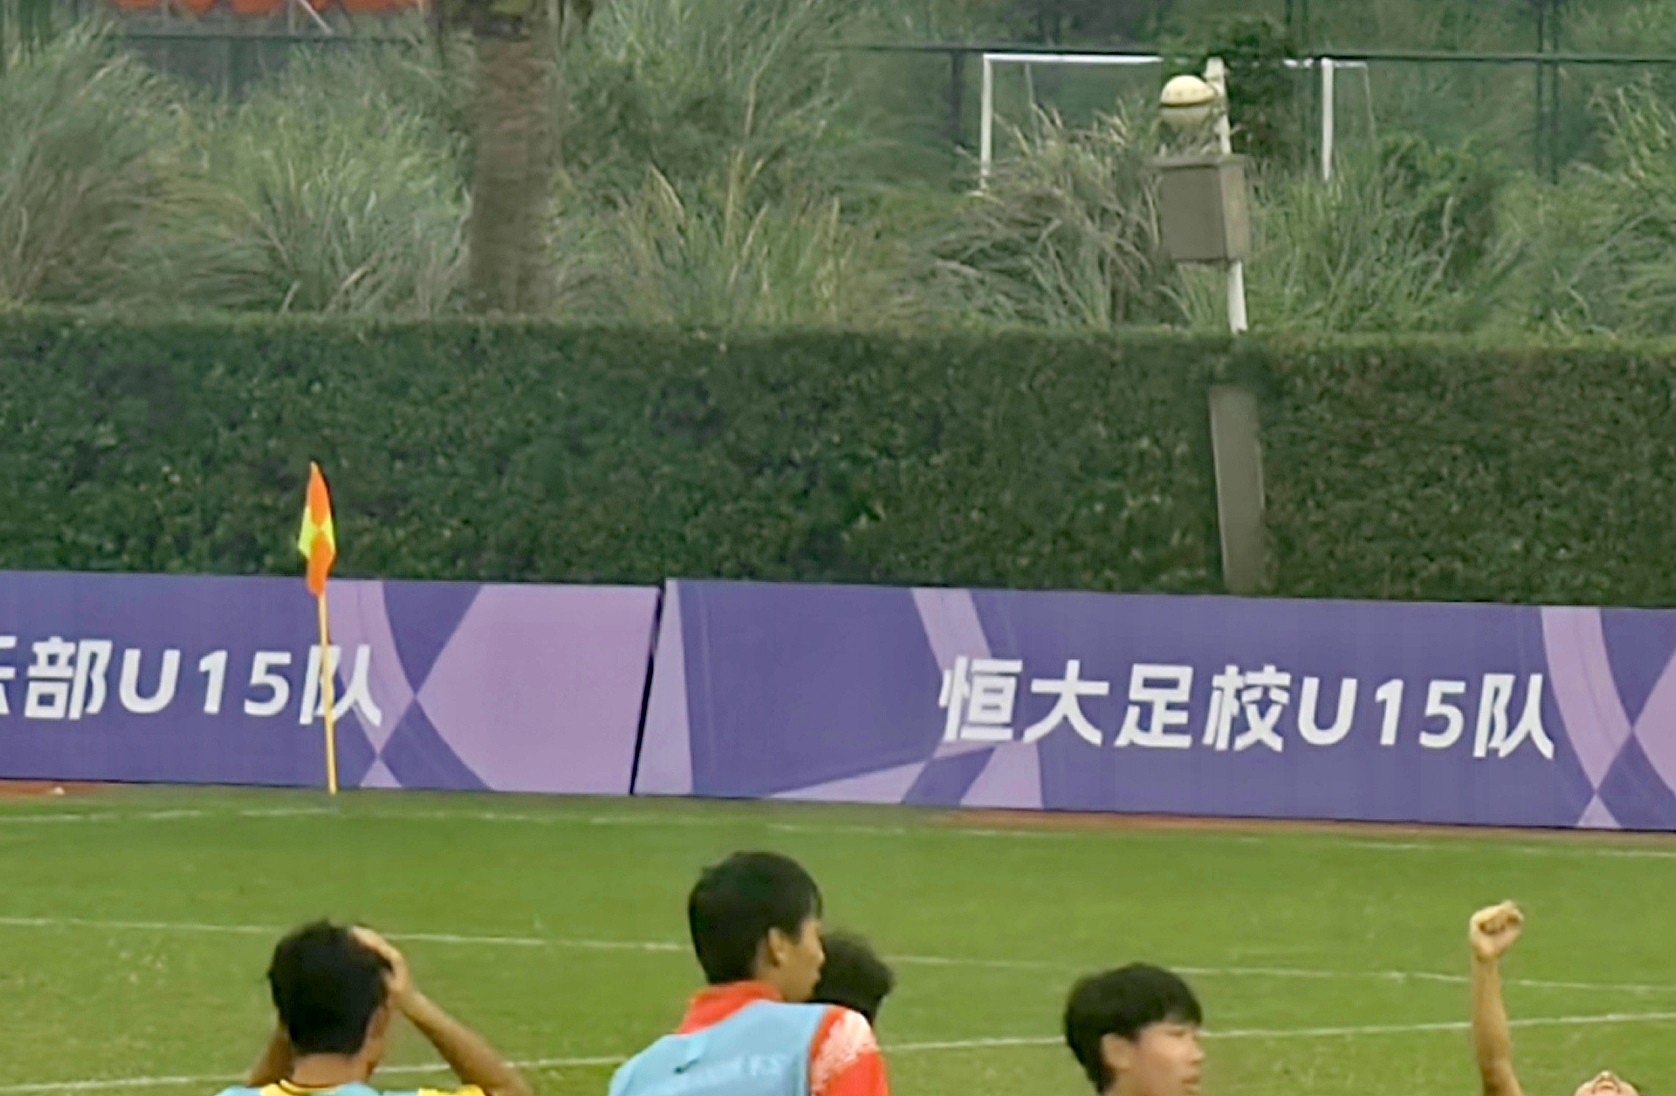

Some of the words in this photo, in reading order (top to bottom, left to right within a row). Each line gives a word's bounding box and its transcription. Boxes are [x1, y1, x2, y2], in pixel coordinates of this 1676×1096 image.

[0, 636, 382, 726] 部U15队
[938, 655, 1555, 761] 恒大足校U15队
